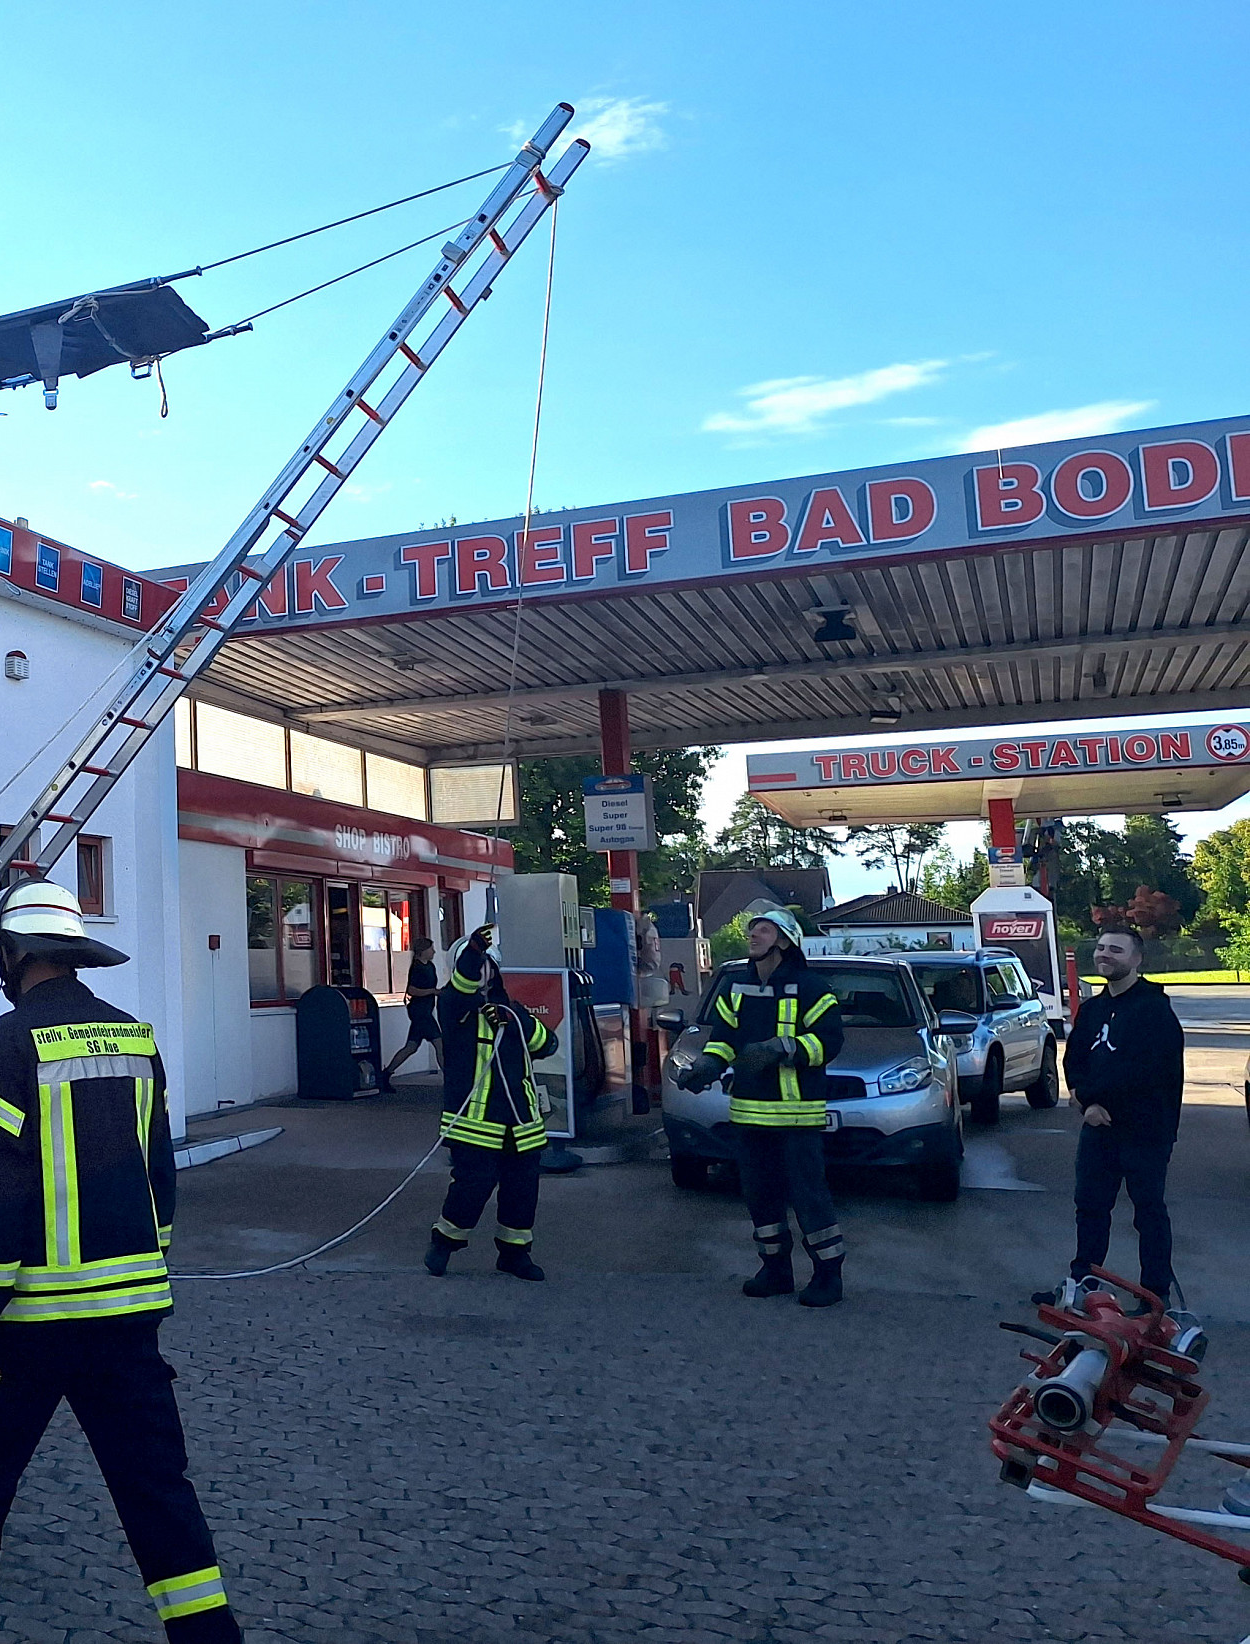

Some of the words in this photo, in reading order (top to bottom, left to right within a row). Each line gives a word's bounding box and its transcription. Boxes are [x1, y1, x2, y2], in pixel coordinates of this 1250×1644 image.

[400, 509, 674, 600] TREFF
[727, 476, 938, 562] BAD
[42, 558, 55, 570] TANK
[813, 745, 961, 780] TRUCK
[993, 732, 1193, 771] STATION
[601, 800, 628, 808] Diesel
[603, 812, 628, 820] Super
[589, 824, 613, 833] Super
[335, 823, 366, 851] SHOP
[373, 831, 411, 861] BISTRO
[991, 921, 1032, 935] hoyer
[36, 1029, 66, 1044] stellv.
[86, 1040, 101, 1053] SG
[103, 1040, 119, 1053] Aue
